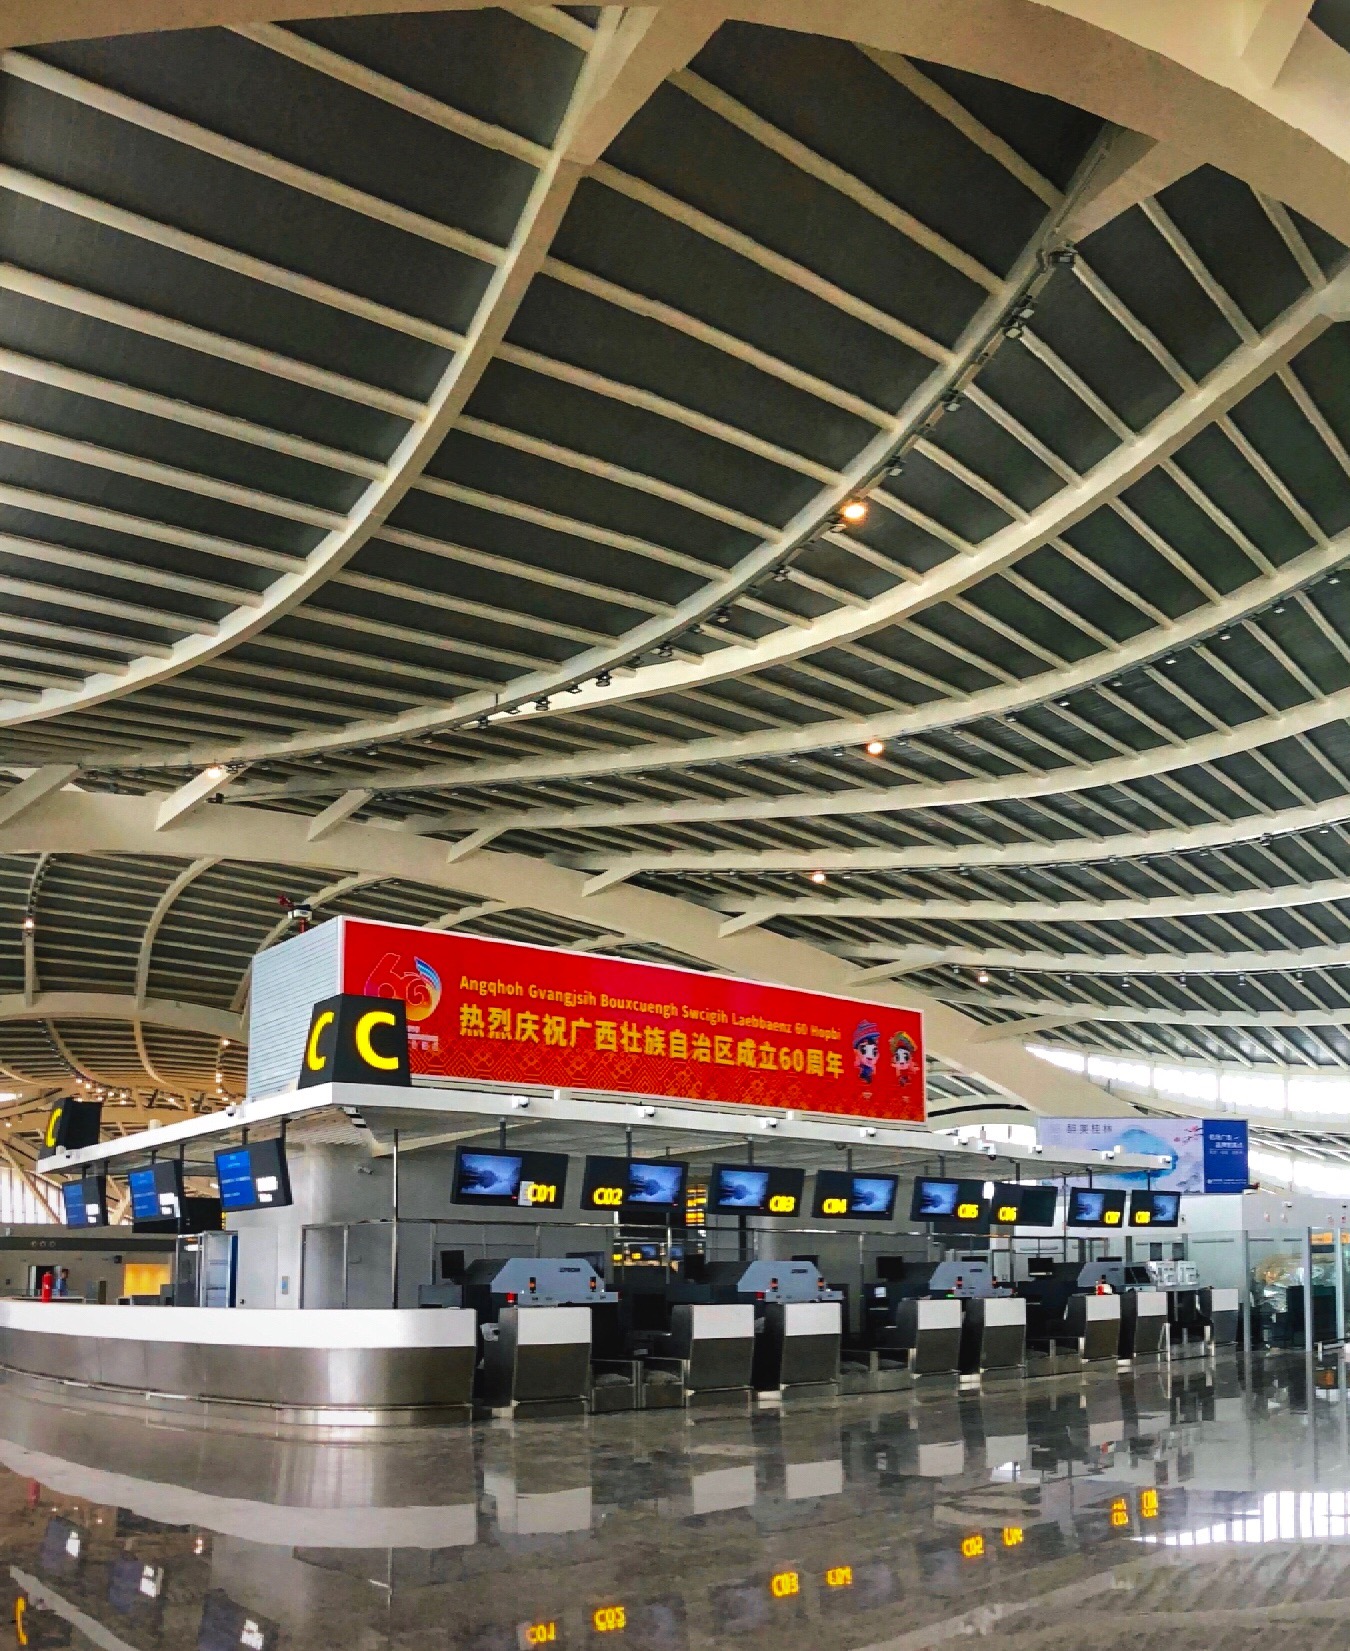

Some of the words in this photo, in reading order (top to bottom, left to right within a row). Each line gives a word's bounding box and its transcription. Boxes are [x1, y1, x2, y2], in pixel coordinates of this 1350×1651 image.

[459, 975, 524, 997] Angqhoh
[355, 1010, 400, 1070] C
[459, 1003, 845, 1079] 热烈庆祝广西壮族自治区成立60周年
[528, 1183, 558, 1203] C01
[592, 1186, 624, 1206] C02
